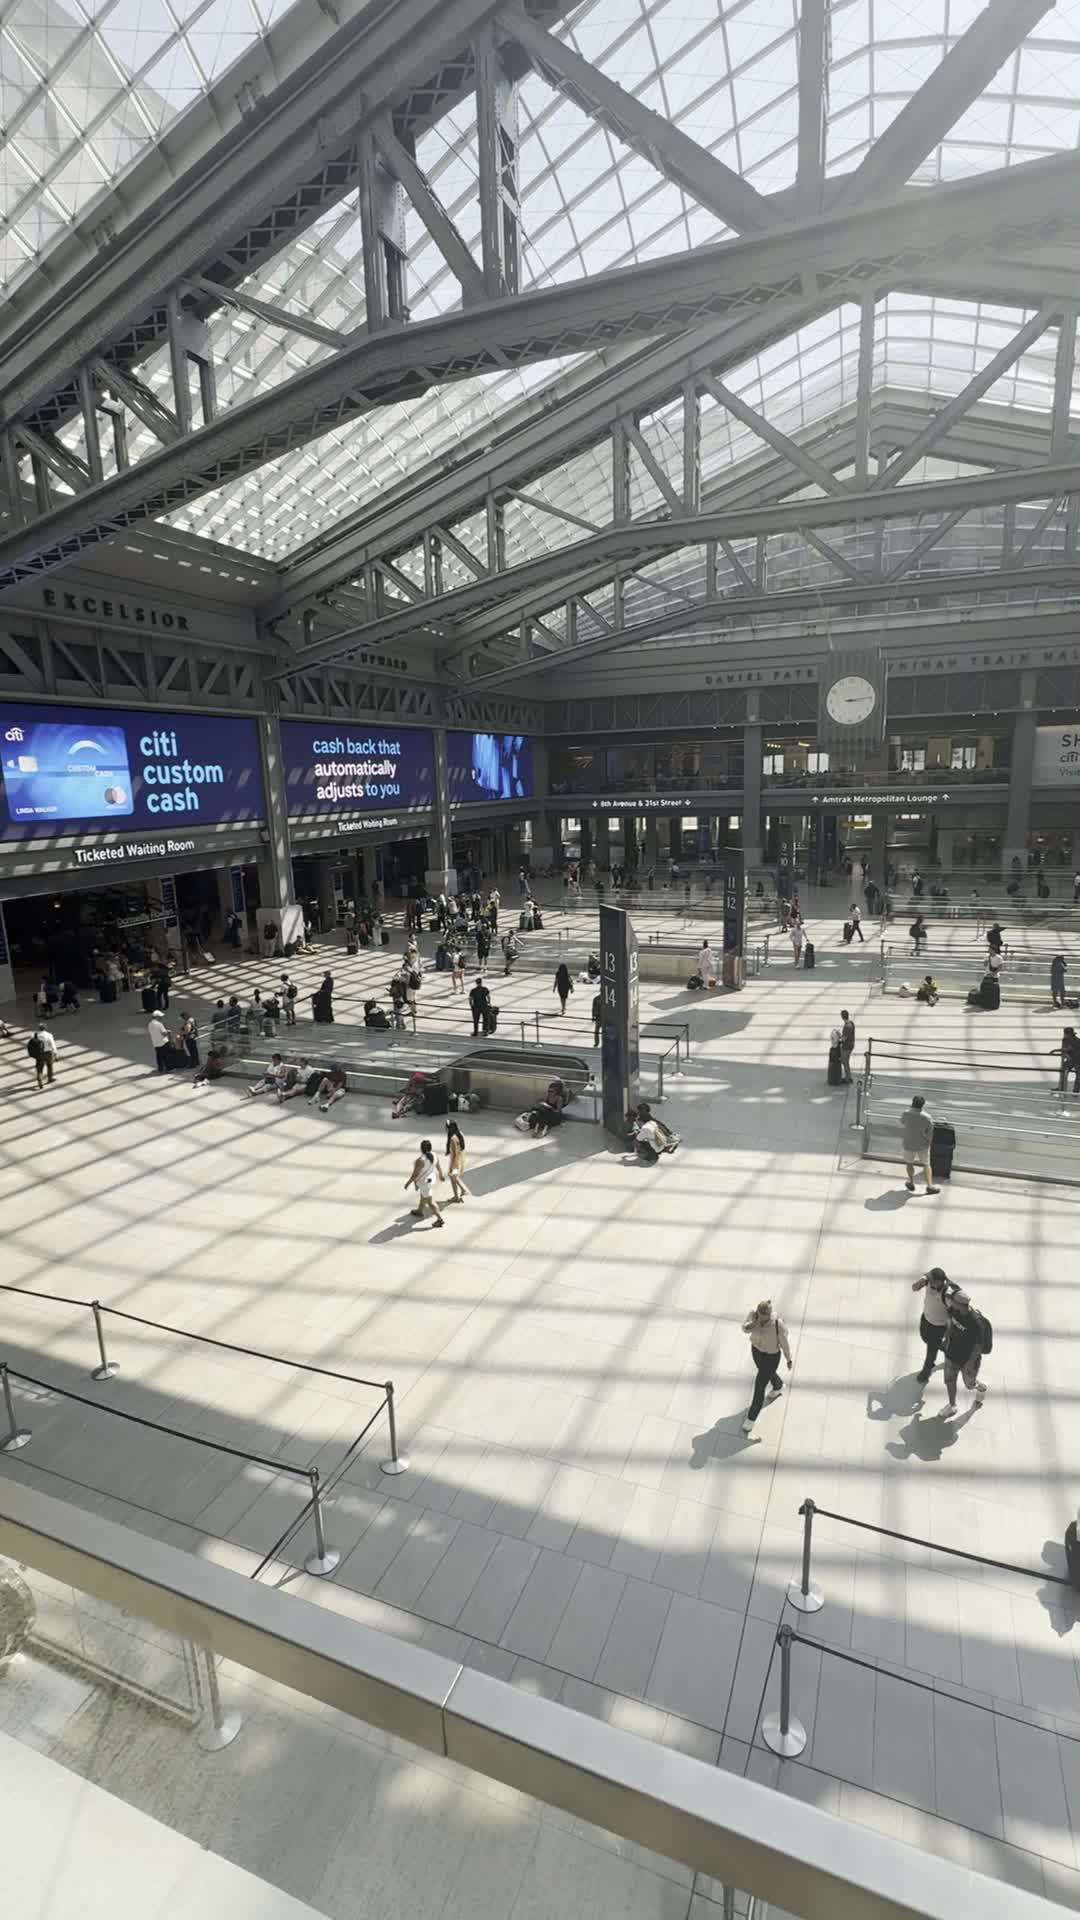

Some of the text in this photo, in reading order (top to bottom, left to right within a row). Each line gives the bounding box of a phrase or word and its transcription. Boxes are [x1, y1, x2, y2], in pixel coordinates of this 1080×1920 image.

[43, 588, 189, 631] EXCELSIOR
[705, 671, 762, 685] DANIEL
[5, 727, 24, 742] citi
[140, 731, 178, 756] citi
[312, 737, 401, 755] cash back that
[143, 759, 224, 784] custom
[314, 759, 397, 779] automatically
[146, 786, 199, 813] cash
[316, 781, 400, 802] adjusts to you
[822, 794, 938, 804] Amtrak Metropolitan Lounge
[612, 800, 637, 808] Avenue
[638, 799, 644, 807] &
[660, 798, 682, 807] Street
[337, 821, 362, 832] Ticketed
[75, 839, 195, 863] Ticketed Waiting Room
[780, 856, 789, 867] 10
[727, 875, 736, 889] 11
[727, 896, 737, 910] 12
[604, 951, 616, 973] 13
[604, 985, 617, 1008] 14
